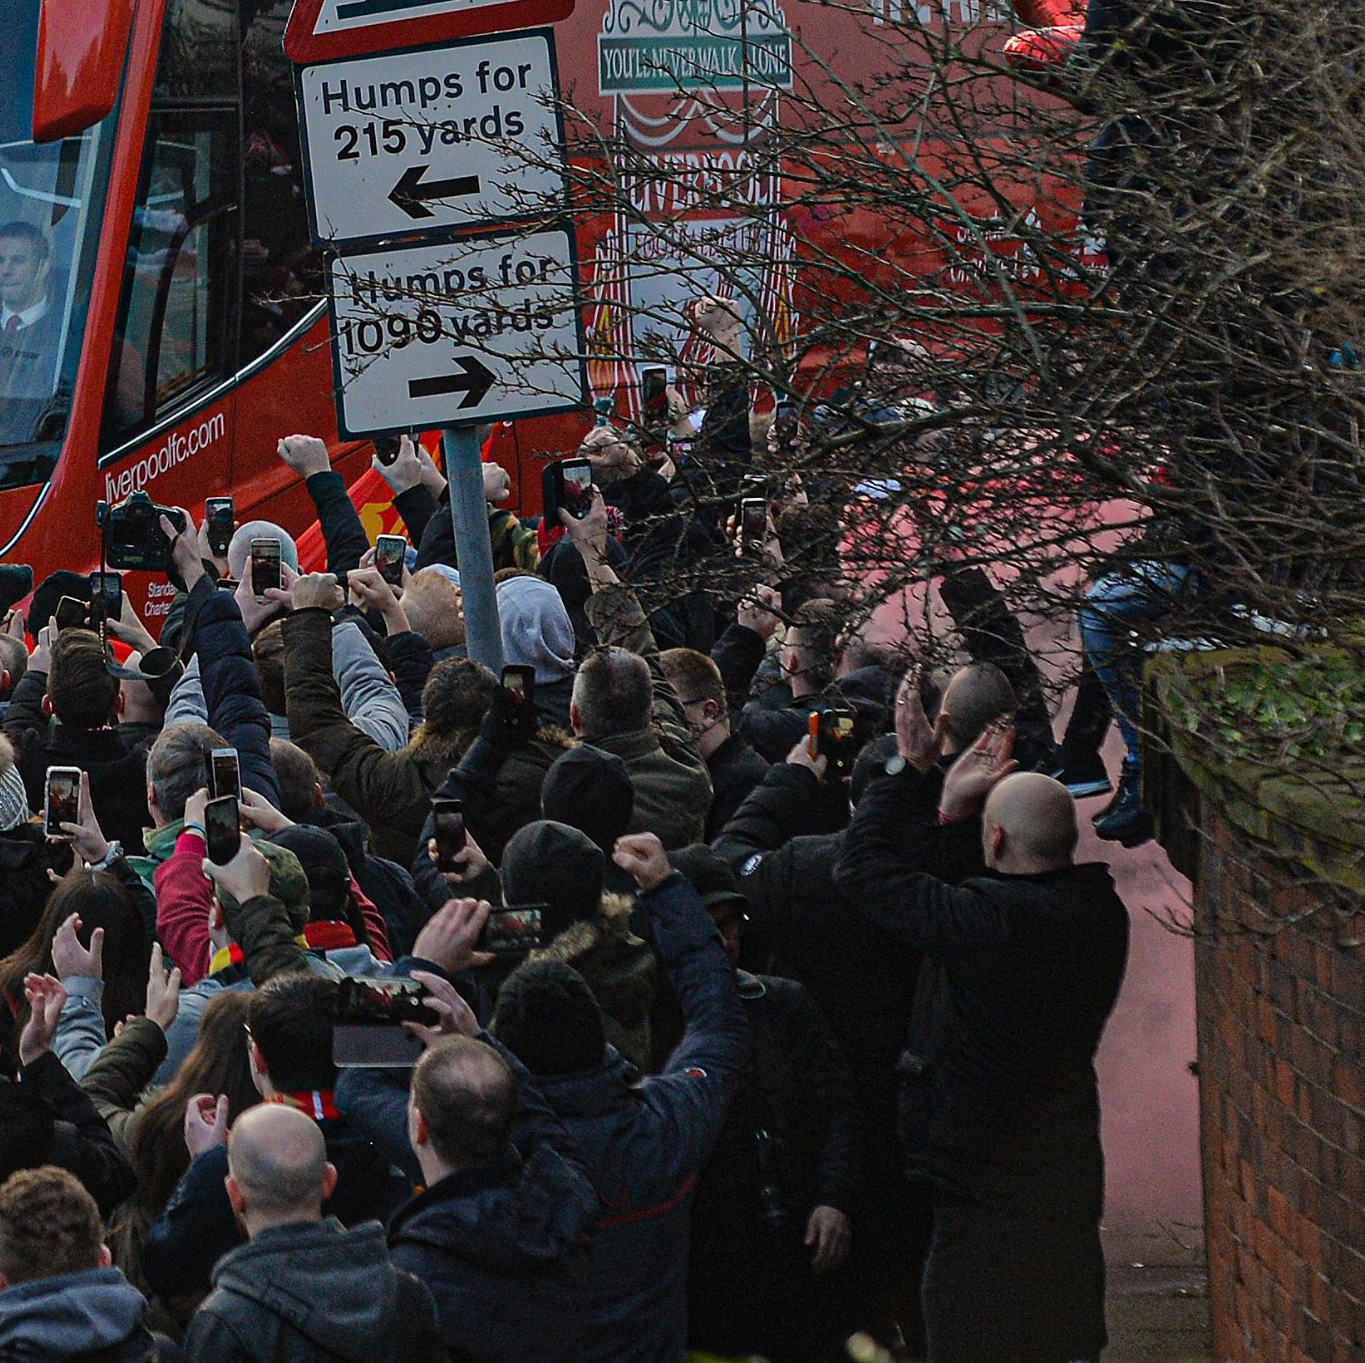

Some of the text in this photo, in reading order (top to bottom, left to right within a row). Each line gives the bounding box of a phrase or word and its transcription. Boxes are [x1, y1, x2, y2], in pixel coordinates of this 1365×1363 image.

[321, 61, 532, 115] Humps for
[652, 47, 697, 78] NEVER
[697, 44, 738, 76] WALK
[333, 105, 525, 161] 215 yards
[351, 253, 554, 306] Humps for
[339, 298, 555, 355] 1090 yards
[104, 411, 226, 504] liverpoolfc.com
